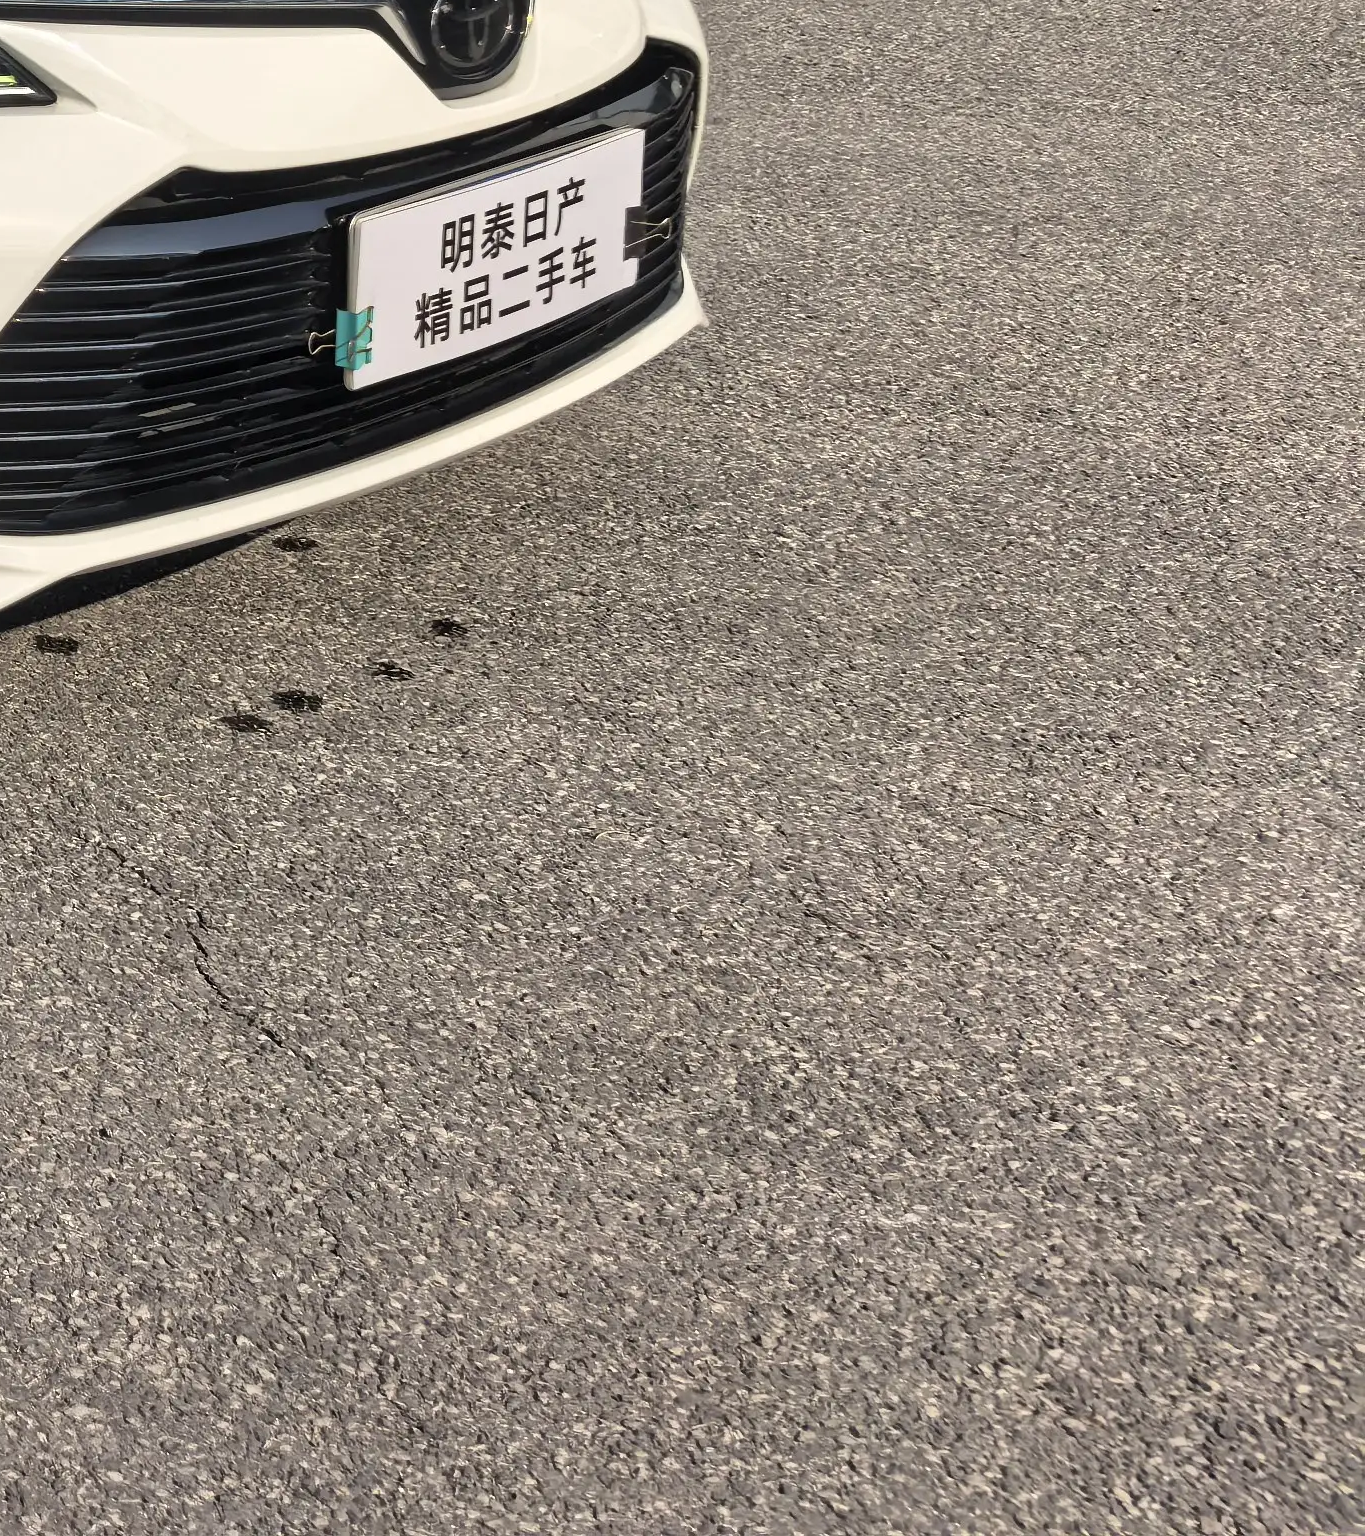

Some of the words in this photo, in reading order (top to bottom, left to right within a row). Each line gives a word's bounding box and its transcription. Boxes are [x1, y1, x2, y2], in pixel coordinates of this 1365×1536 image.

[440, 176, 586, 273] 明泰日产
[413, 235, 598, 348] 精品二手车
